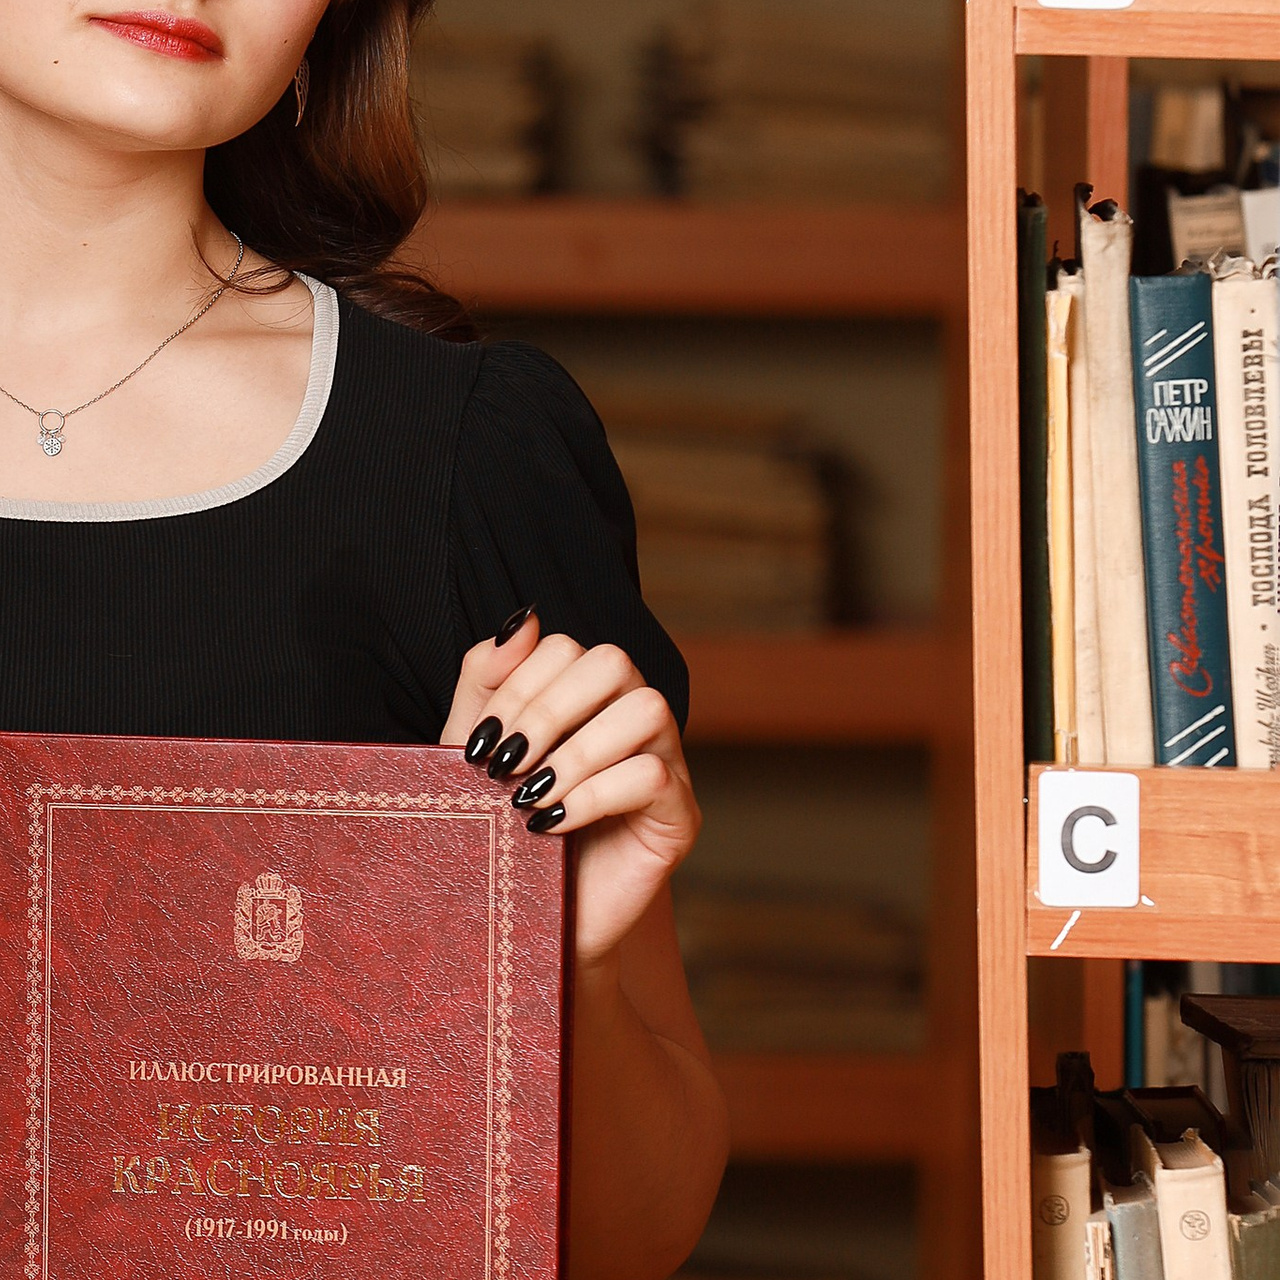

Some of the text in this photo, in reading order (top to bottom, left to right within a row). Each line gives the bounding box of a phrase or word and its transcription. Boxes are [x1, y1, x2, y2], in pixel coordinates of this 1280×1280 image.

[1152, 378, 1209, 408] ПЕТР
[1240, 327, 1271, 479] ГОЛОВЛЕВЫ
[1145, 407, 1213, 444] САЖИН
[1246, 493, 1276, 608] ГОСПОДА
[1060, 804, 1119, 874] С
[129, 1060, 407, 1088] ИЛЛЮСТРИРОВАННАЯ
[157, 1103, 382, 1147] ИСТОРИЯ
[111, 1155, 427, 1203] КРАСНОЯРЬЯ
[184, 1217, 348, 1245] (1917-1991 годы)
